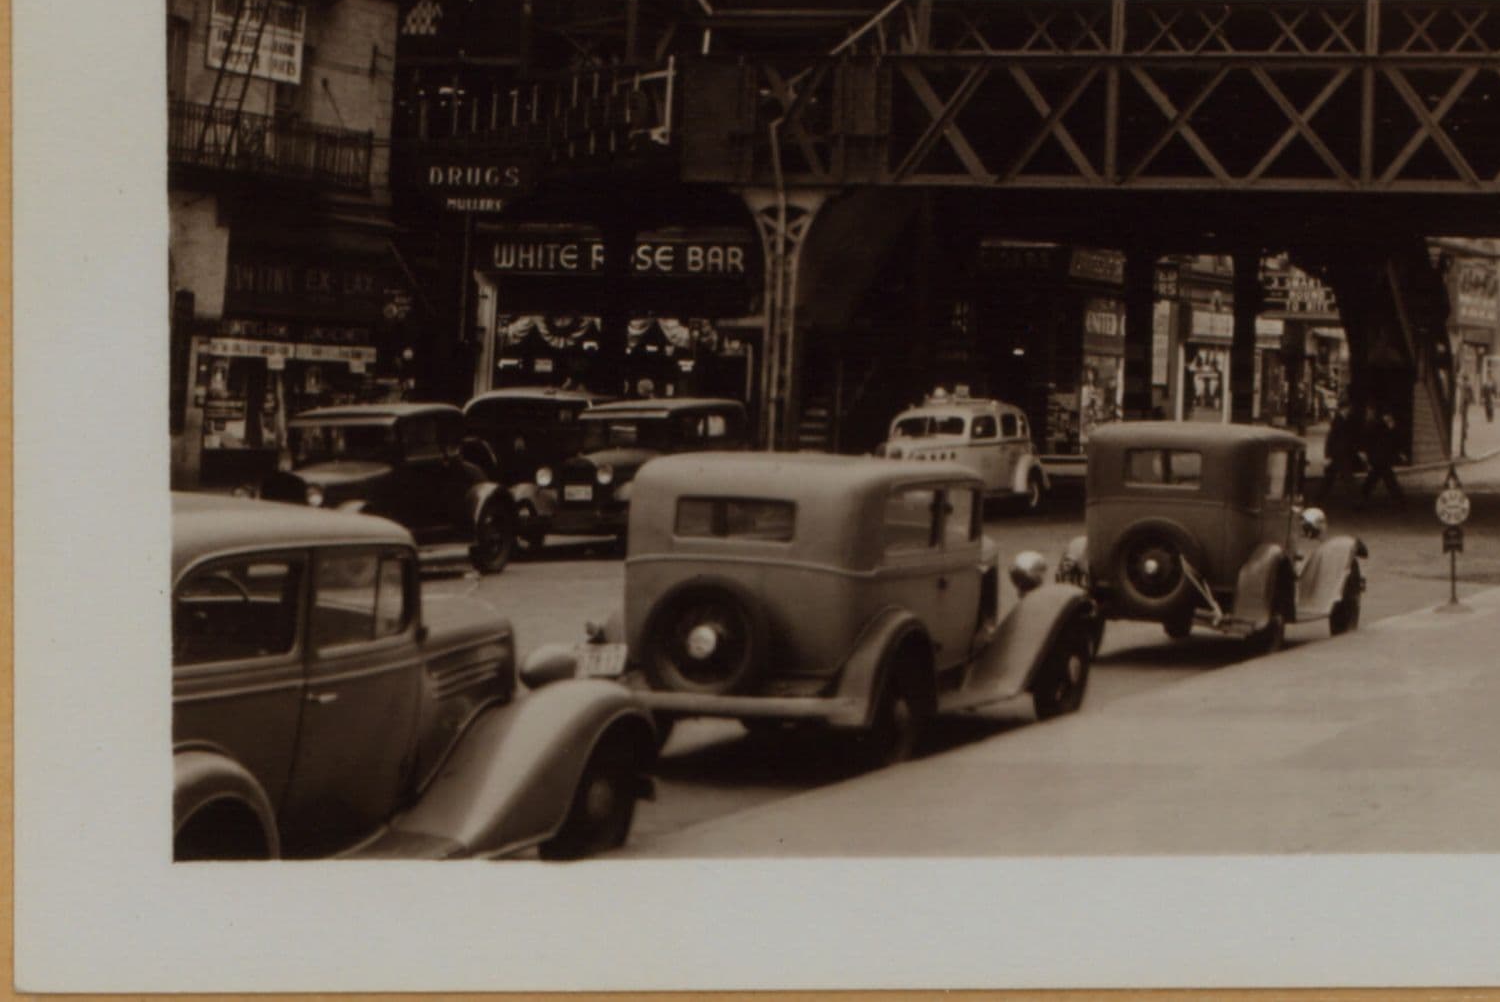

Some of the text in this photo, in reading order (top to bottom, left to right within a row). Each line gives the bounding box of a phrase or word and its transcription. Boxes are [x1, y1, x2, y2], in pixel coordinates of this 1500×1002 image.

[429, 166, 520, 188] DRUGS
[494, 244, 743, 272] WHITE RSE BAR
